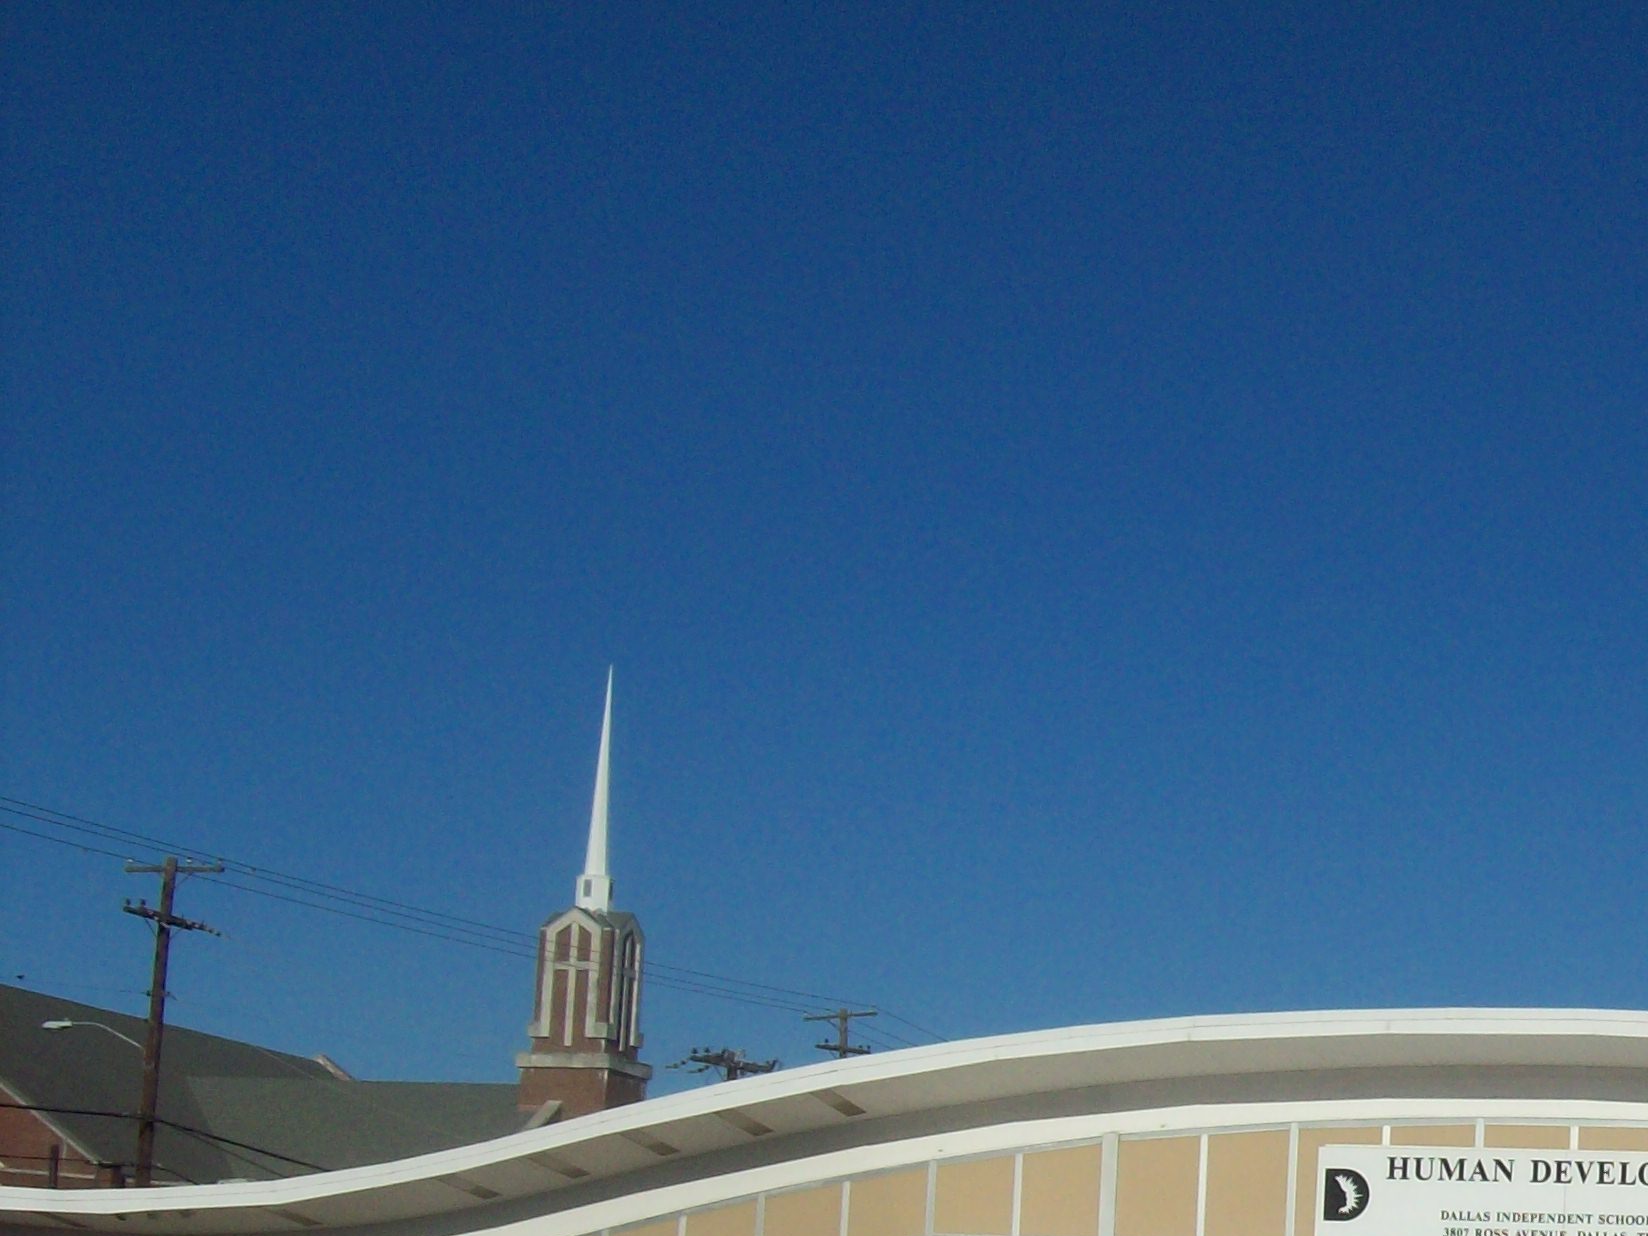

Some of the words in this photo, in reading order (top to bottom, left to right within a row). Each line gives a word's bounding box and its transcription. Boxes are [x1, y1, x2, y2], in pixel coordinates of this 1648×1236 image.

[1386, 1156, 1515, 1182] HUMAN
[1441, 1210, 1491, 1222] DALLAS
[1496, 1212, 1594, 1225] INDEPENDENT
